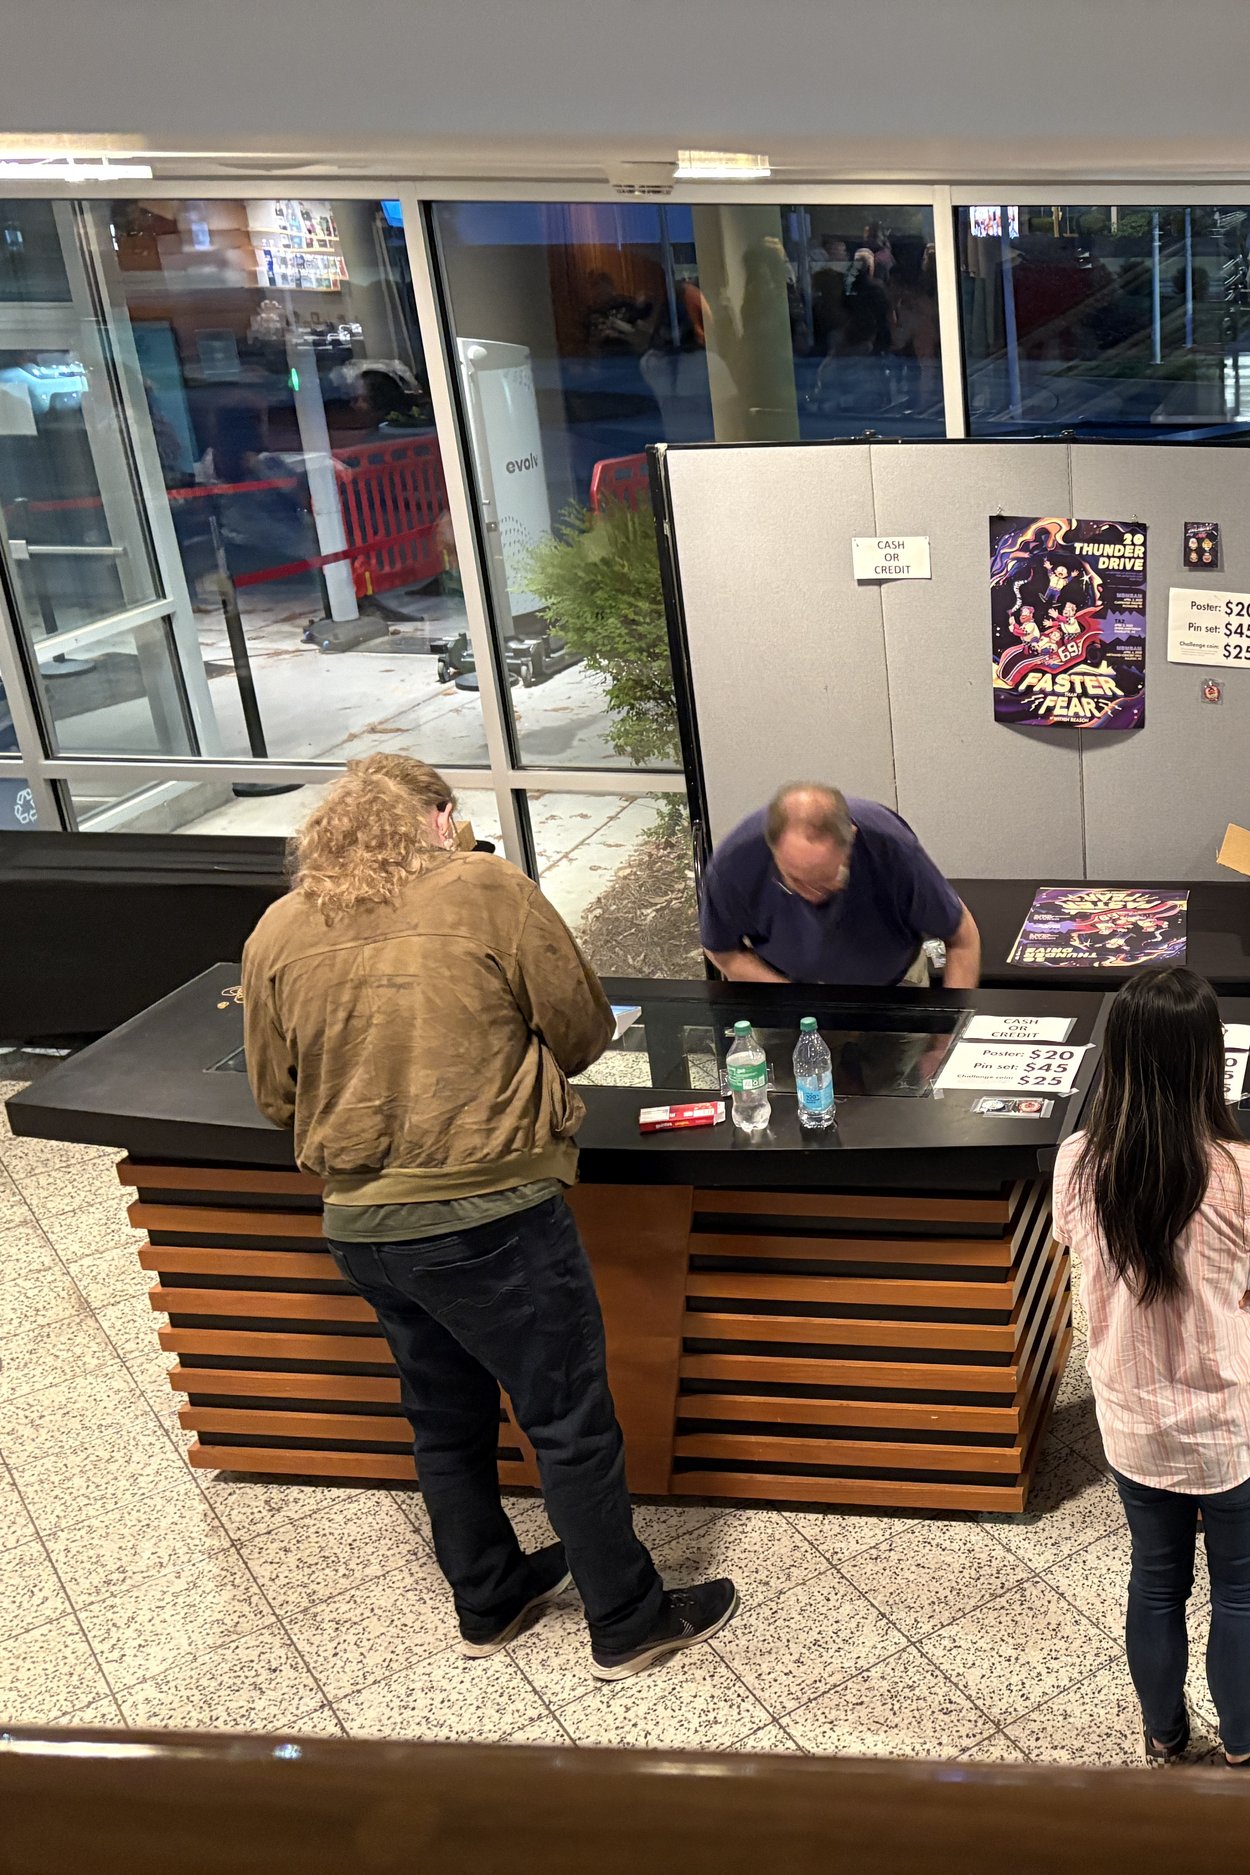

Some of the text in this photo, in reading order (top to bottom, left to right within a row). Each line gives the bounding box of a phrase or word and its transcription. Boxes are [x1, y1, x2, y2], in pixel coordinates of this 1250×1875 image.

[506, 452, 538, 474] evolv
[877, 540, 905, 549] CASH
[1123, 533, 1145, 545] 20
[1074, 543, 1145, 558] THUNDER
[884, 553, 900, 562] OR
[874, 565, 911, 574] CREDIT
[1098, 557, 1144, 571] DRIVE
[1191, 601, 1221, 612] Poster:
[1188, 622, 1202, 632] Pin
[1205, 626, 1220, 634] set:
[1179, 641, 1205, 649] Challenge
[1058, 642, 1079, 662] 69
[1018, 672, 1125, 696] FASTER
[982, 1049, 1074, 1061] Poster: $20
[973, 1062, 1069, 1073] Pin set: $45
[1017, 1075, 1063, 1086] $25
